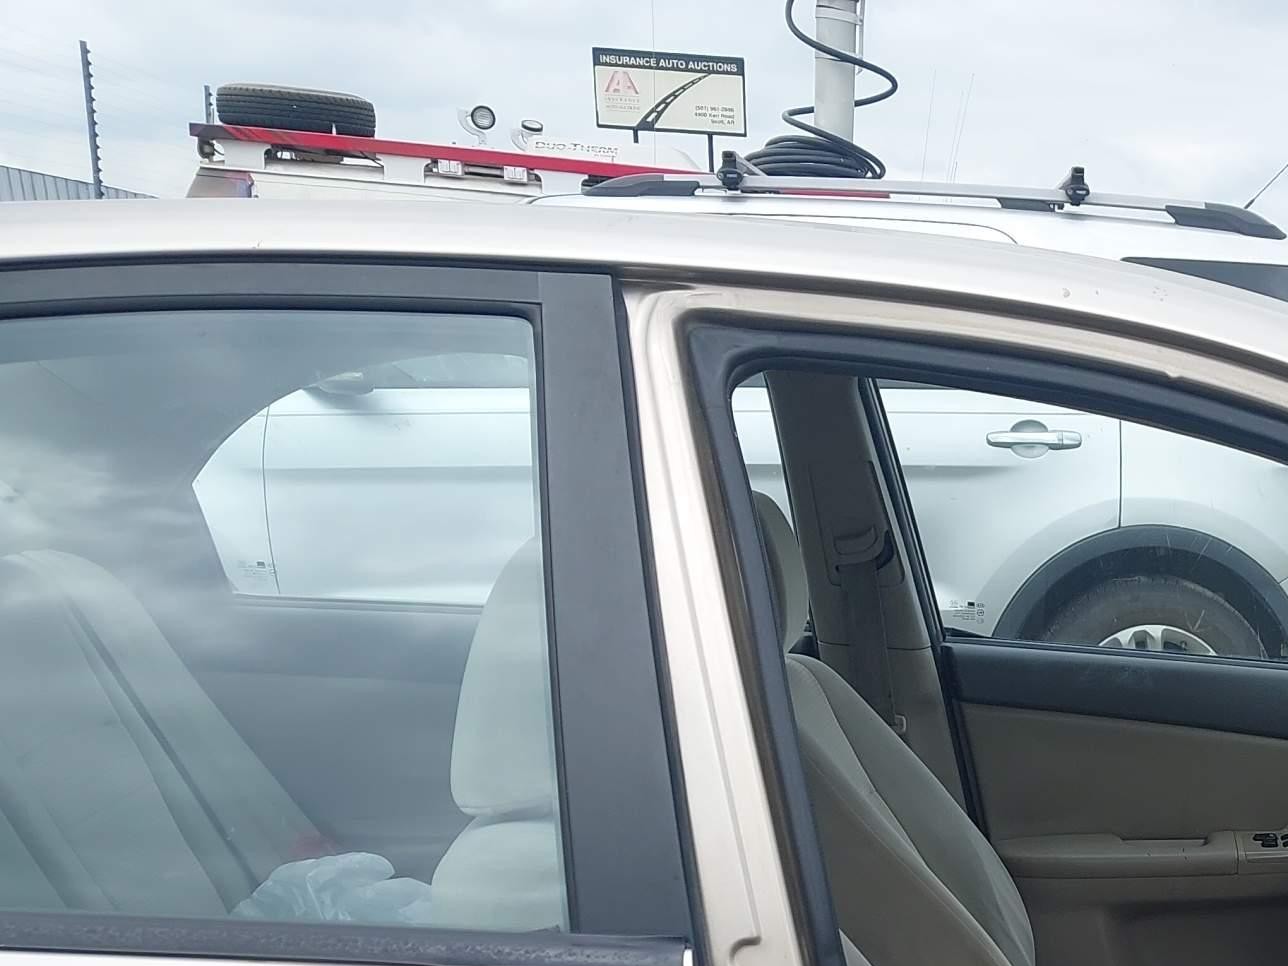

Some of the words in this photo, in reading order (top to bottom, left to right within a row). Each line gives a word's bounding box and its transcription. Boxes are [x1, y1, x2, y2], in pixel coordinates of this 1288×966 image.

[600, 54, 657, 67] INSURANCE
[659, 58, 686, 69] AUTO
[688, 61, 738, 73] AUCTIONS
